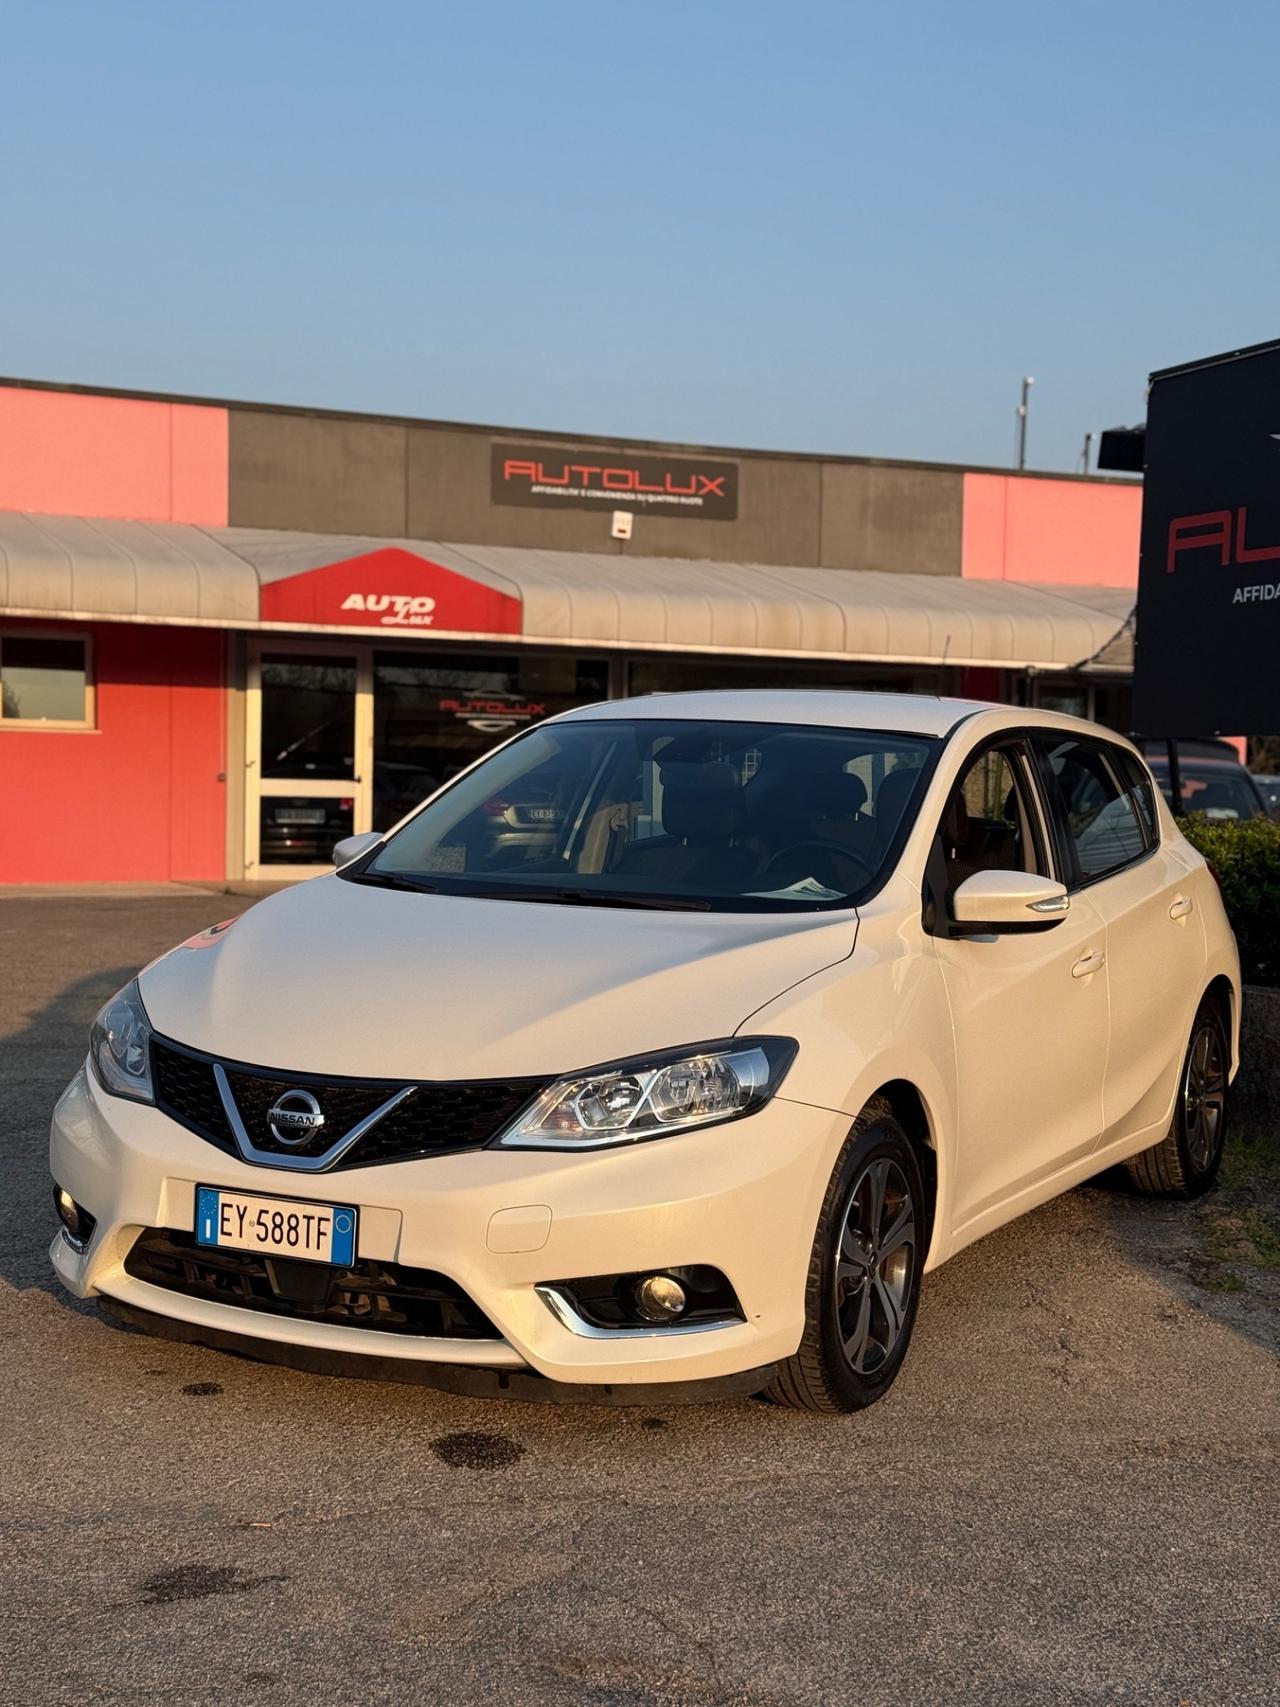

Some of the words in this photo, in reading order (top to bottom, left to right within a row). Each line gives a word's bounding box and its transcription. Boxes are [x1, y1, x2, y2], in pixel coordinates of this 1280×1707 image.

[504, 460, 724, 496] AUTOLUX
[341, 593, 435, 614] AUTO
[440, 700, 545, 714] AUTOLUX
[269, 1111, 315, 1126] NISSAN
